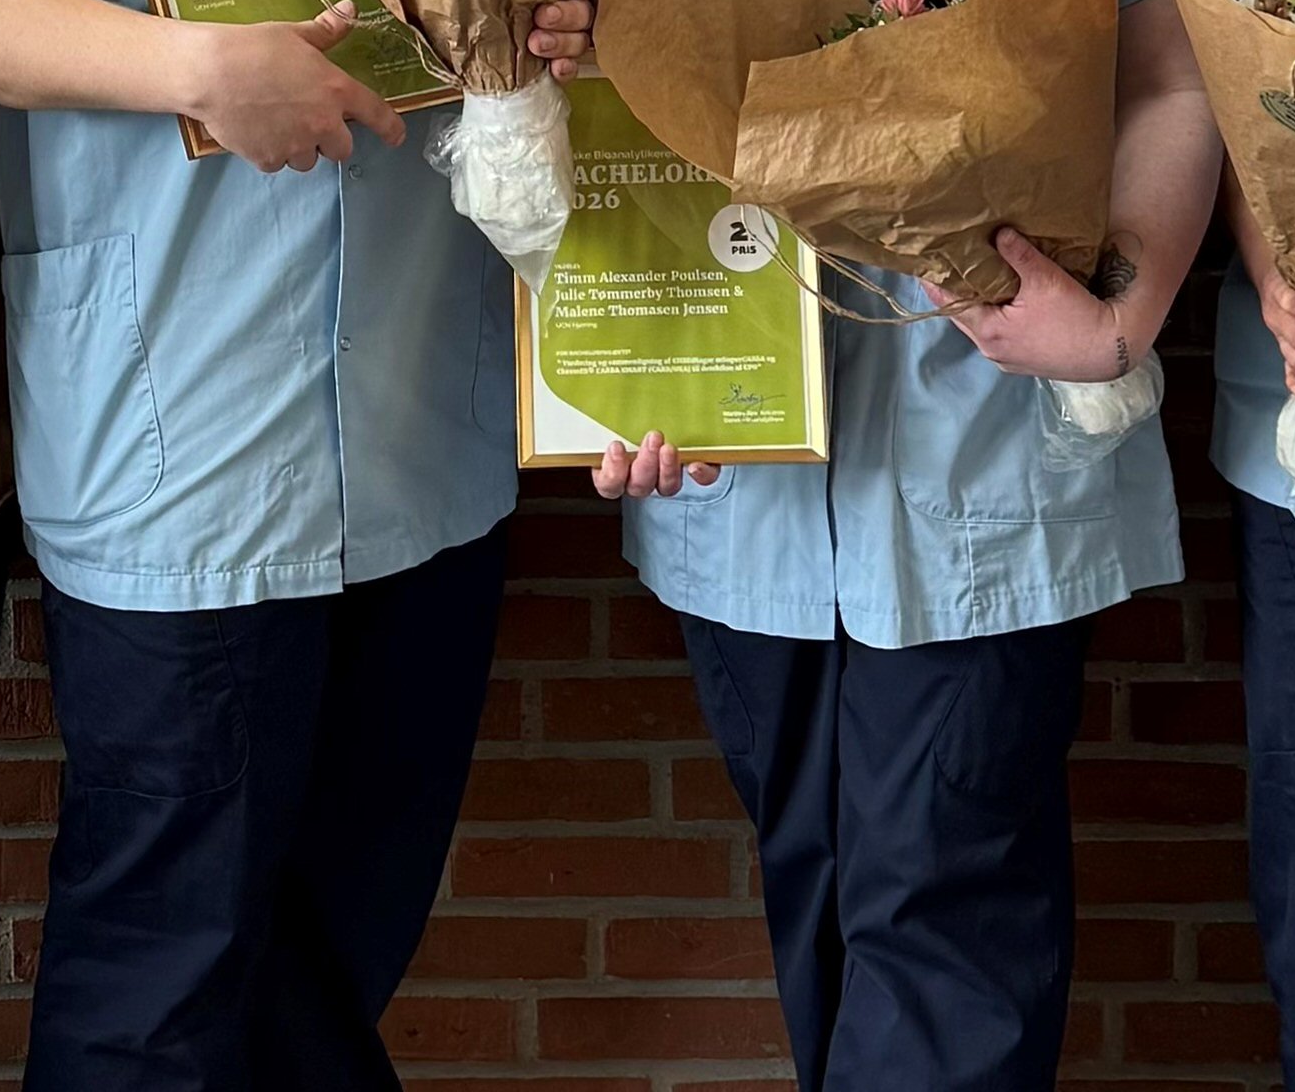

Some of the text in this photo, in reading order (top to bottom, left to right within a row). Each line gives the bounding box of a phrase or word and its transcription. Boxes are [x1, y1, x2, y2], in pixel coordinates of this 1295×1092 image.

[594, 149, 677, 162] Bioanalytikere
[574, 162, 717, 185] ACHELOR
[573, 188, 620, 210] 026
[731, 245, 757, 255] PRIS
[554, 269, 728, 284] Timm Alexander Poulsen,
[555, 285, 744, 302] Julie Tømmerby Thomsen &
[555, 303, 728, 318] Malene Thomasen Jensen
